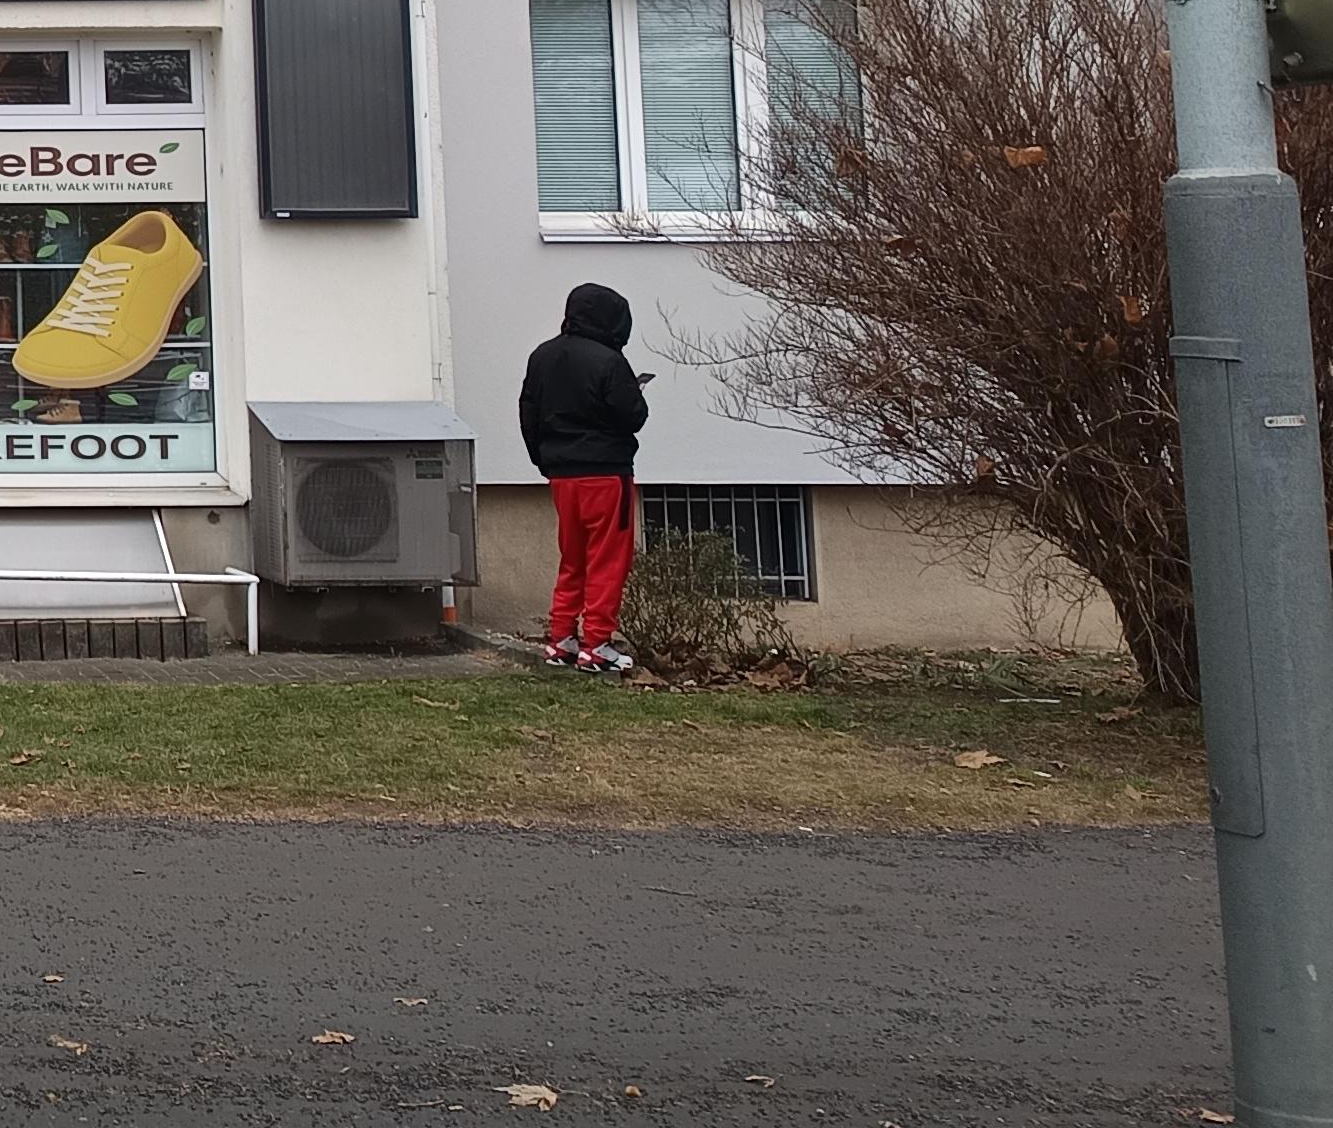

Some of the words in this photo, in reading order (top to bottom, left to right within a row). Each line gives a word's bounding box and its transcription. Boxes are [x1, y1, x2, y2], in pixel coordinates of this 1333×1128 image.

[13, 183, 53, 192] EARTH,
[56, 182, 90, 191] WALK
[93, 182, 124, 191] WITH
[127, 182, 174, 191] NATURE
